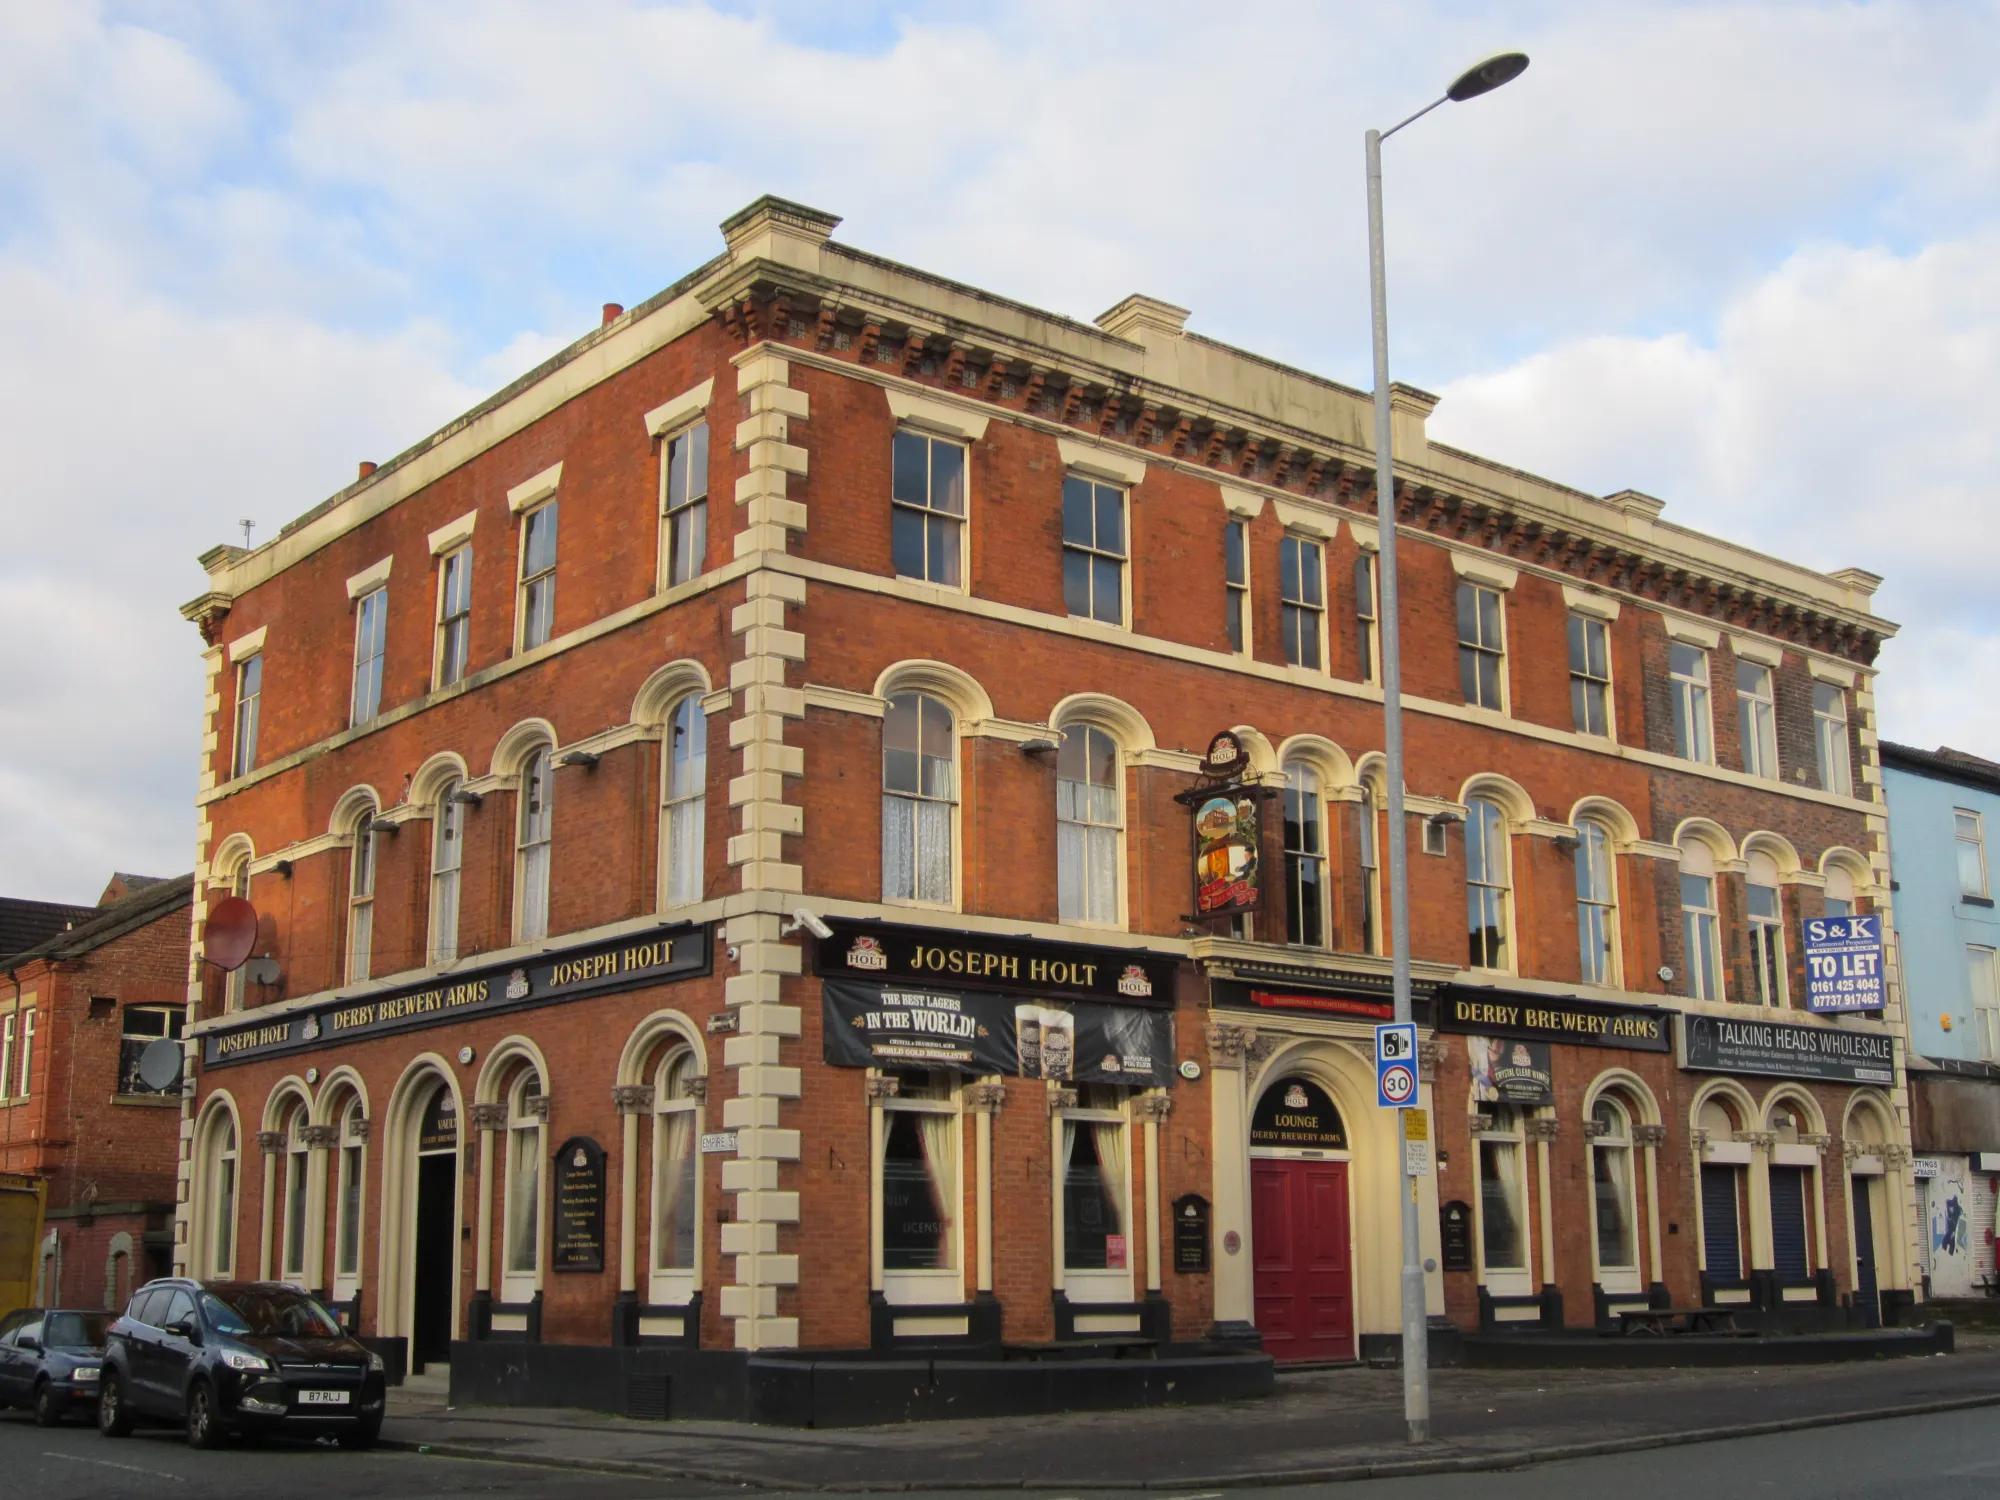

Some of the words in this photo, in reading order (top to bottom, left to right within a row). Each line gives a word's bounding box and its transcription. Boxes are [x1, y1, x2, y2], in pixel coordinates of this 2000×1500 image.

[1212, 751, 1236, 762] HOLT
[550, 952, 617, 986] JOSEPH
[624, 940, 673, 971] HOLT
[850, 954, 884, 966] HOLT
[910, 946, 1018, 978] JOSEPH
[1030, 958, 1097, 986] HOLT
[1810, 956, 1836, 978] TO
[1842, 954, 1878, 976] LET
[506, 986, 528, 996] HOLT
[1120, 982, 1150, 993] HOLT
[1812, 981, 1834, 993] 0161
[1836, 980, 1854, 991] 425
[1856, 978, 1880, 990] 4042
[334, 1005, 376, 1030] DERBY
[379, 990, 444, 1020] BREWERY
[446, 980, 488, 1007] ARMS
[881, 993, 900, 1004] THE
[902, 994, 925, 1006] BEST
[926, 996, 960, 1011] LAGERS
[1814, 994, 1842, 1007] 07737
[1844, 992, 1880, 1005] 917462
[866, 1012, 881, 1028] IN
[883, 1012, 910, 1028] THE
[910, 1008, 976, 1038] WORLD!
[1456, 1002, 1518, 1025] DERBY
[1525, 1009, 1609, 1034] BREWERY
[1612, 1018, 1659, 1040] ARMS
[216, 1030, 257, 1054] JOSEPH
[260, 1024, 290, 1045] HOLT
[939, 1041, 956, 1049] LAGER
[1716, 1022, 1772, 1048] TALKING
[1776, 1028, 1816, 1052] HEADS
[1819, 1032, 1890, 1058] WHOLESALE
[877, 1046, 904, 1055] WORLD
[905, 1048, 925, 1056] GOLD
[926, 1050, 968, 1060] MEDALISTS
[1495, 1068, 1514, 1079] CRYSTAL
[1516, 1068, 1531, 1078] CLEAR
[1387, 1077, 1408, 1092] 30
[1286, 1097, 1308, 1105] HOLT
[1275, 1114, 1319, 1128] LOUNGE
[703, 1136, 724, 1148] EMPIRE
[1252, 1130, 1278, 1139] DERBY
[1281, 1132, 1318, 1141] BREWERY
[902, 1222, 948, 1233] LICENSE
[309, 1392, 320, 1401] B7
[323, 1392, 340, 1401] RLJ
